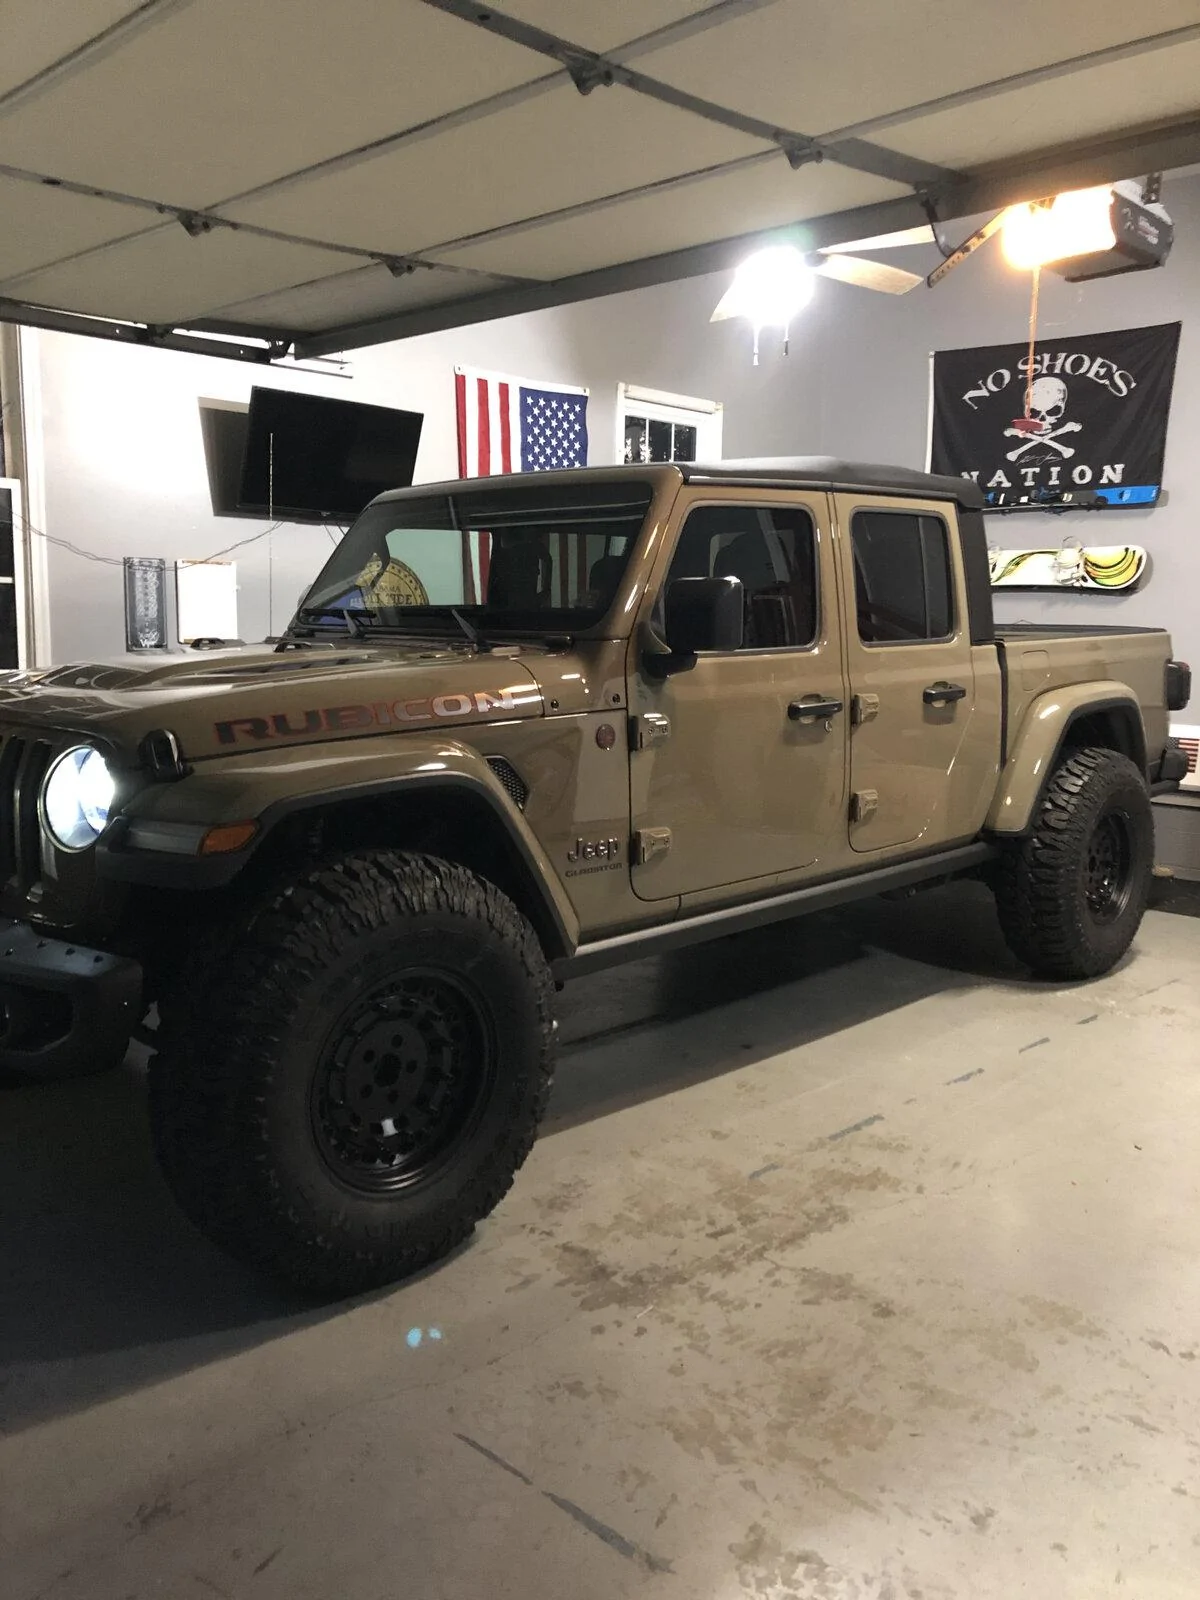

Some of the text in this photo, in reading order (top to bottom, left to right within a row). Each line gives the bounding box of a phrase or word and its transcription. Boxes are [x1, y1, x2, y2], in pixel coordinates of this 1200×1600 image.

[962, 352, 1136, 410] NO SHOES
[962, 464, 1125, 488] NATION
[214, 689, 515, 744] RUBICON
[567, 837, 618, 863] Jeep
